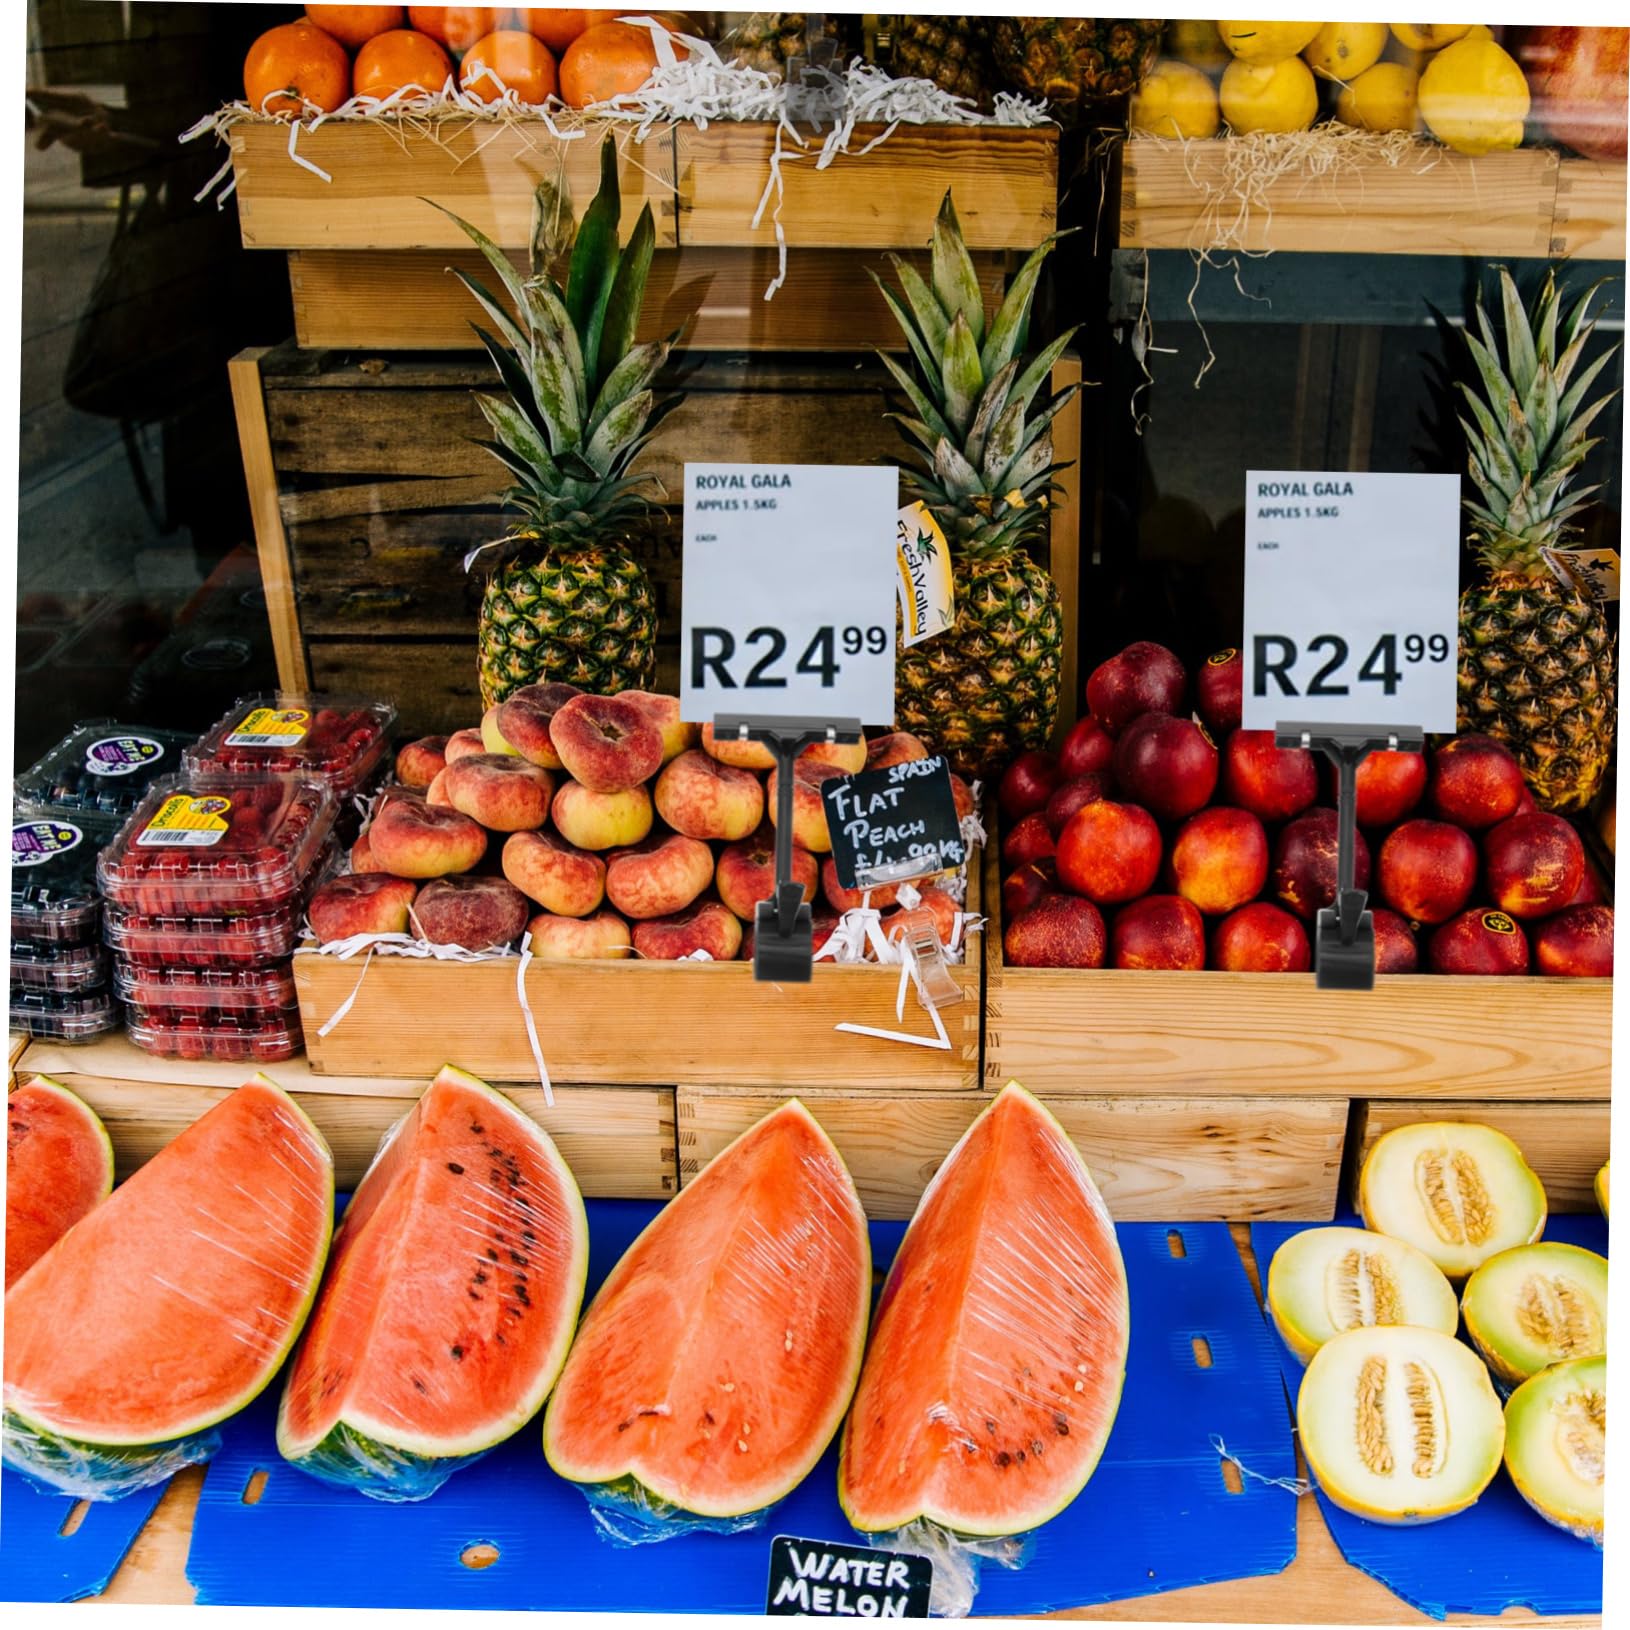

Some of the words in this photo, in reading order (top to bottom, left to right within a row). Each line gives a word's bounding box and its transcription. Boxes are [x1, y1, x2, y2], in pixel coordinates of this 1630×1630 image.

[695, 474, 747, 489] ROYAL
[751, 473, 792, 489] GALA
[1257, 482, 1309, 497] ROYAL
[1313, 481, 1354, 497] GALA
[695, 499, 739, 511] APPLES
[743, 498, 778, 510] 1.5KG
[1257, 507, 1301, 519] APPLES
[1305, 506, 1340, 518] 1.5KG
[897, 519, 929, 637] FreshValley
[888, 755, 942, 784] SPAIN
[827, 784, 905, 821] FLAT
[843, 819, 926, 849] PEACH
[787, 1546, 911, 1589] WATER
[772, 1575, 909, 1618] MELON
